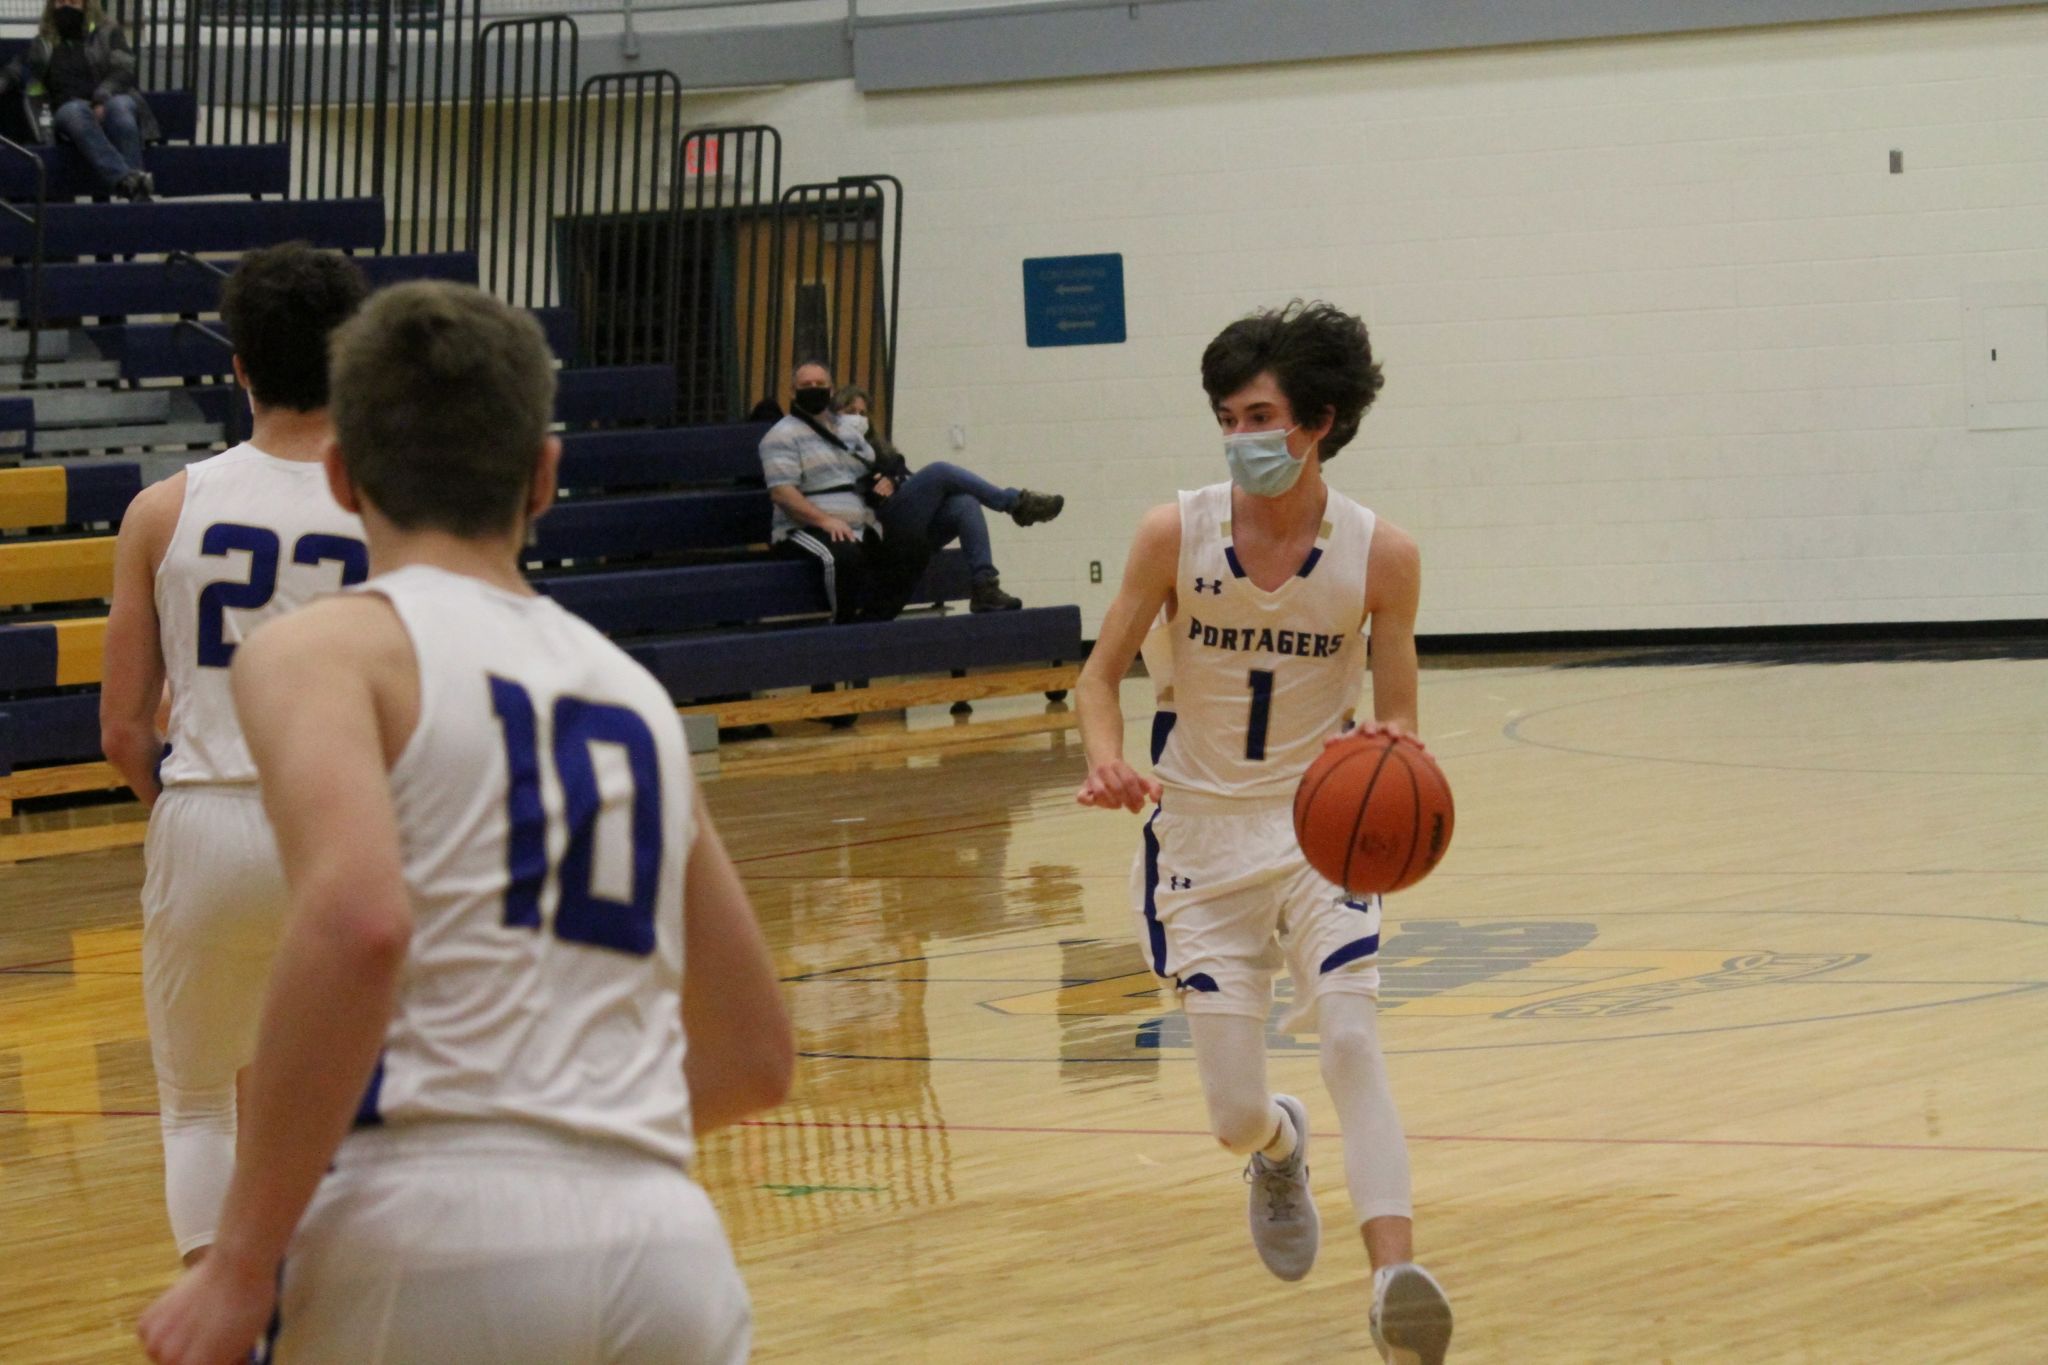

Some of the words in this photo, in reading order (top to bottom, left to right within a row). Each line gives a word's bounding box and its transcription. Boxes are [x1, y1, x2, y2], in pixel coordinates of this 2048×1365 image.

[1187, 616, 1345, 658] PORTAGERS
[1246, 669, 1275, 761] 1
[486, 670, 664, 958] 10
